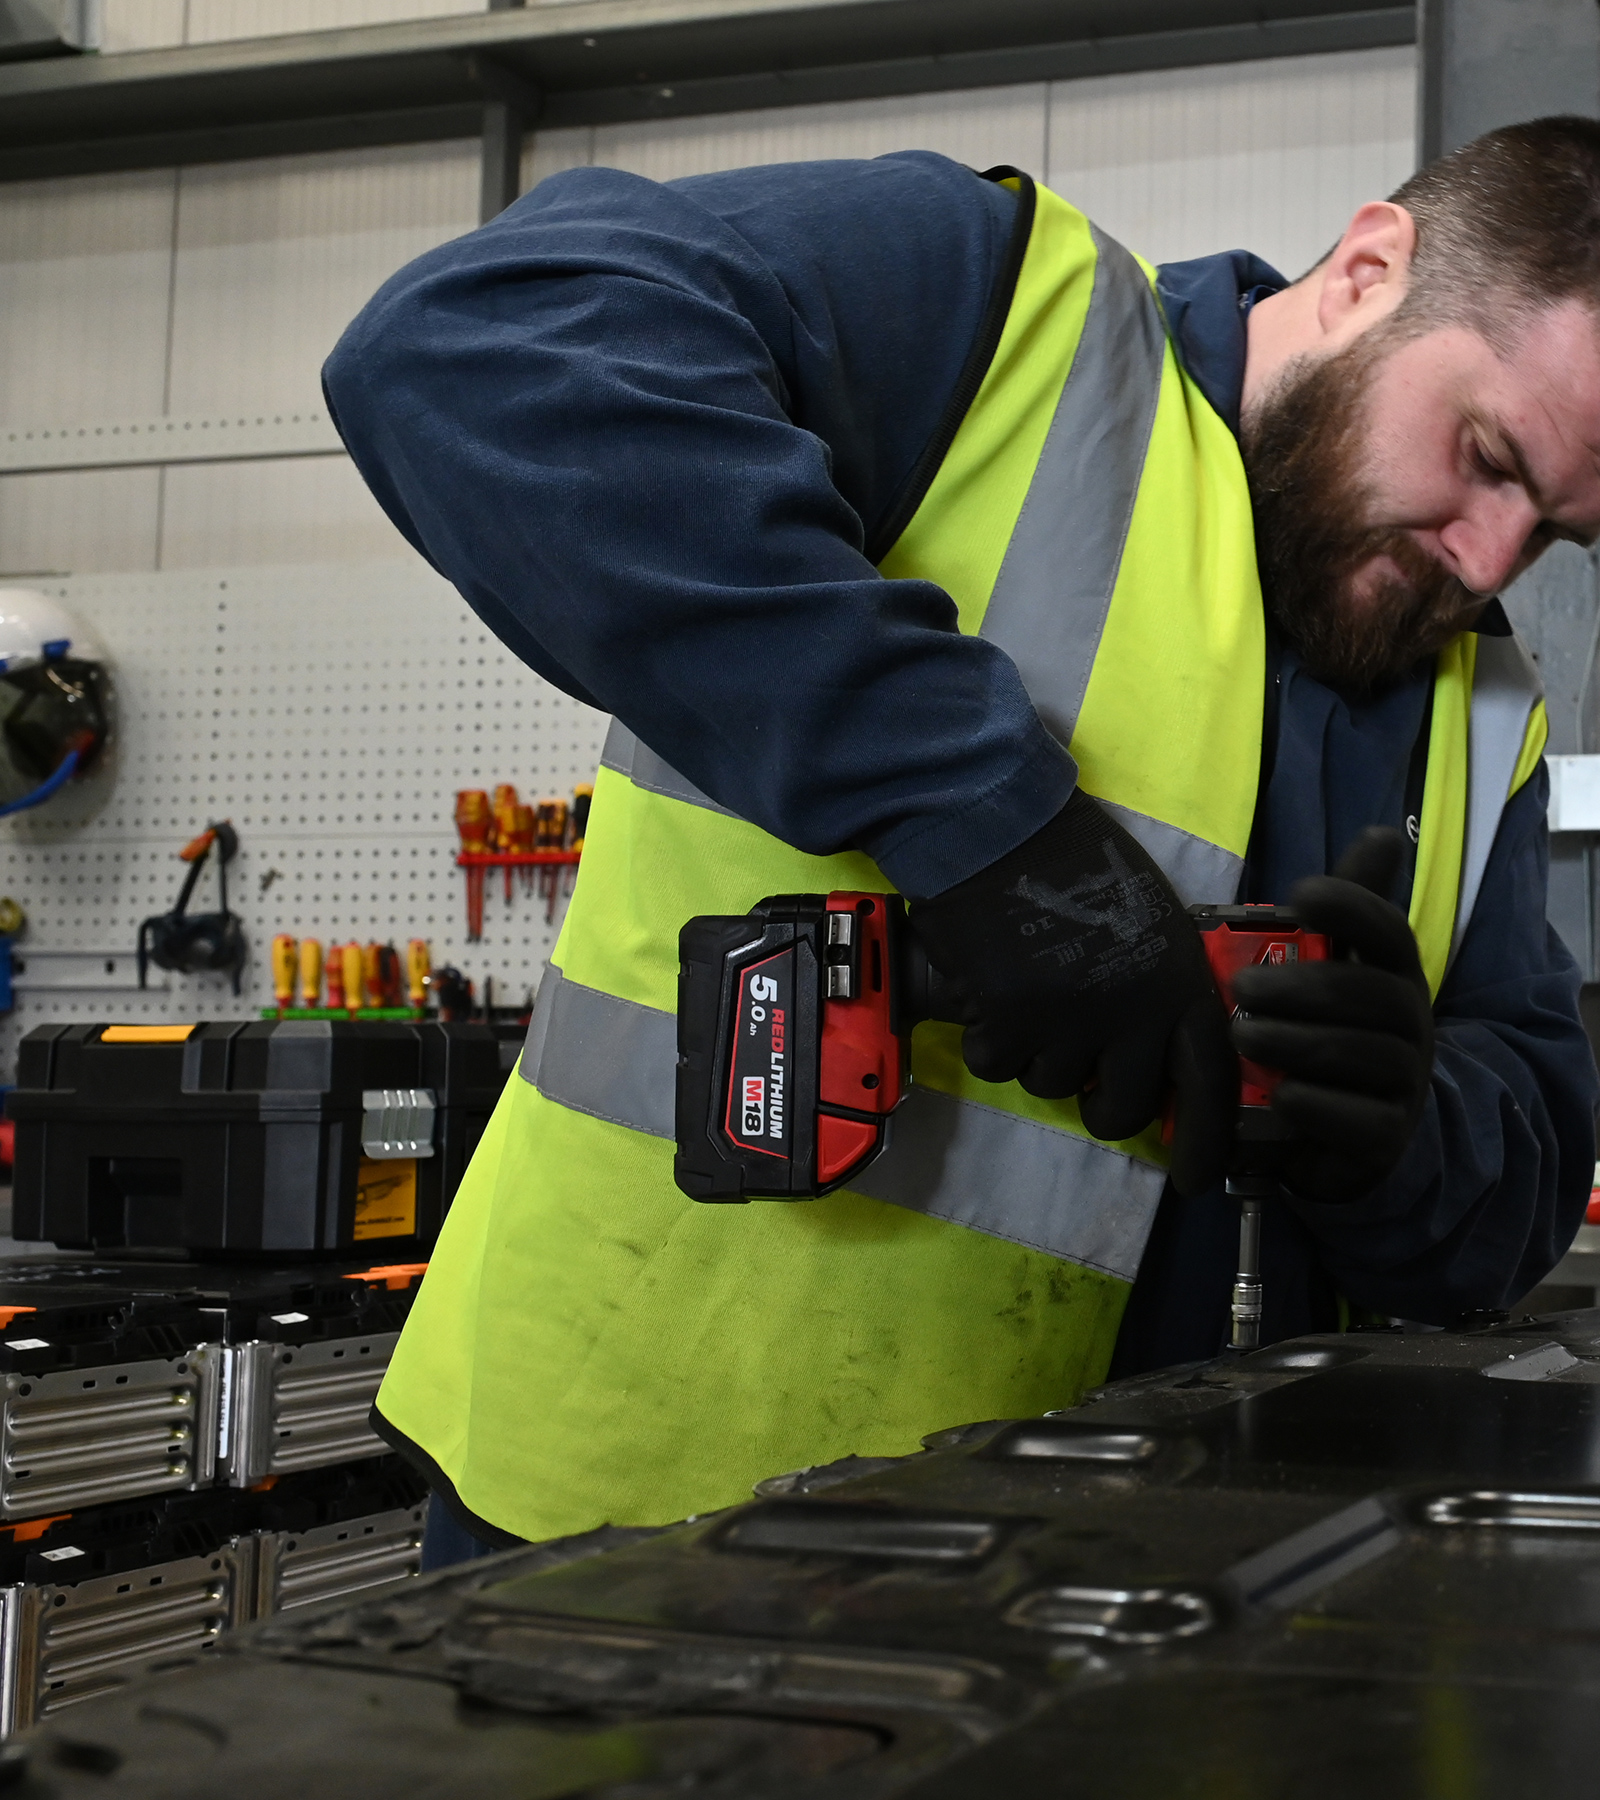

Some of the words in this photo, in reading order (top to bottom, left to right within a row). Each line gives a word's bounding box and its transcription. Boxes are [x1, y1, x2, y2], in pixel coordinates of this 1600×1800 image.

[1020, 915, 1055, 936] 10
[1088, 935, 1168, 983] EDGE
[750, 974, 778, 1022] 5.0
[750, 1022, 757, 1036] Ah
[770, 1008, 785, 1139] REDLITHIUM
[745, 1080, 762, 1132] M18
